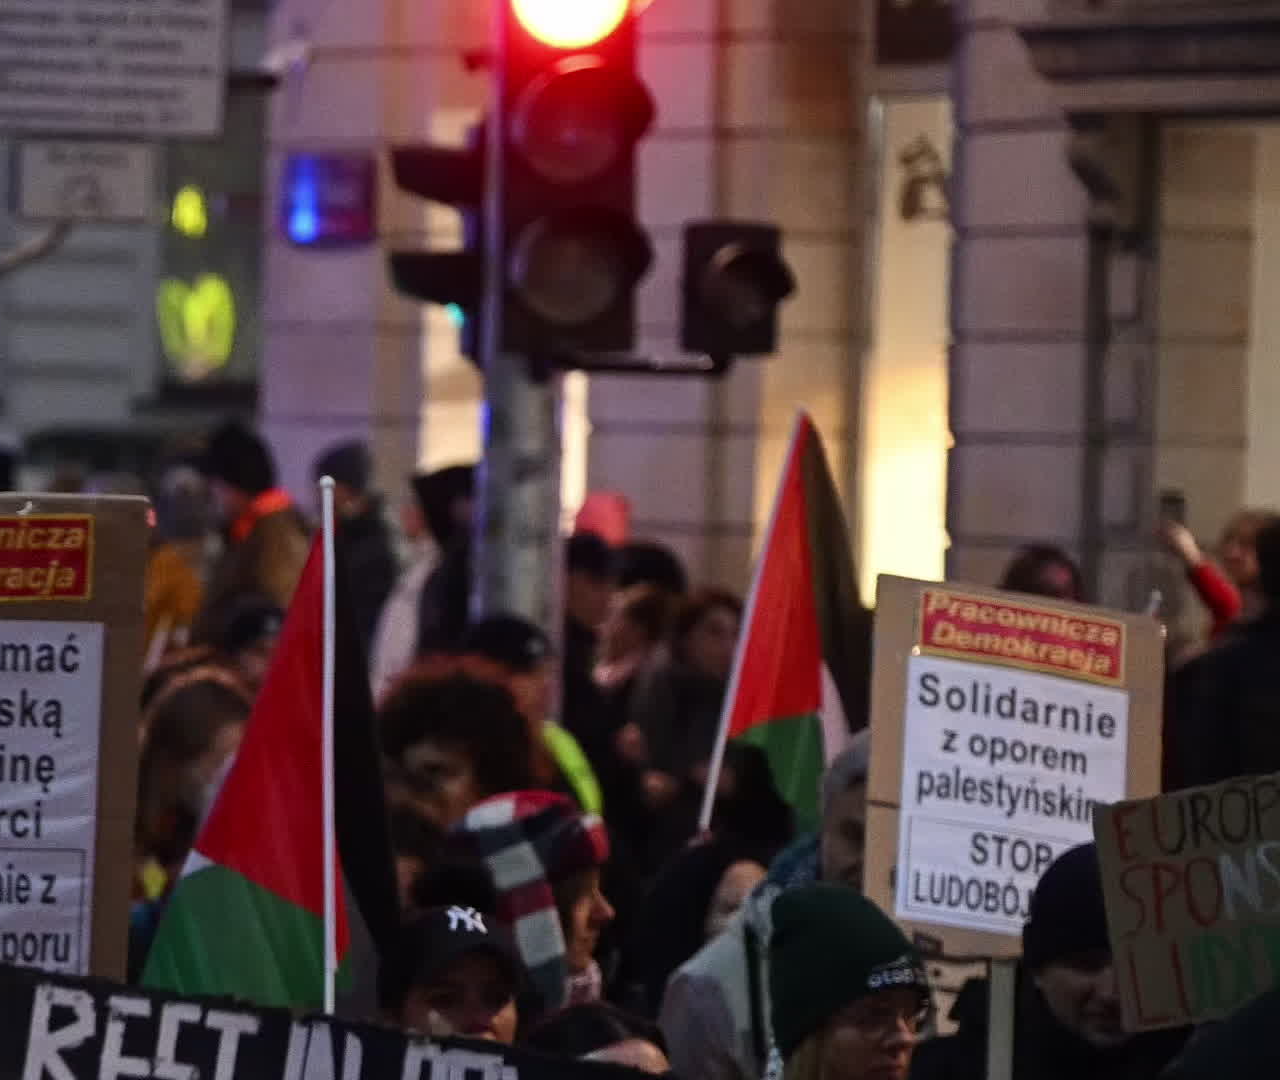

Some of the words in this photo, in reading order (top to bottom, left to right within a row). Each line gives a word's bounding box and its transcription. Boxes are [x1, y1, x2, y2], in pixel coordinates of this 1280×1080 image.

[925, 590, 1120, 646] Pracownicza
[931, 623, 1113, 675] Demokracja
[918, 673, 1118, 740] Solidarnie
[942, 728, 958, 754] z
[968, 731, 1089, 776] oporem
[970, 831, 1053, 876] STOP
[40, 873, 58, 905] z
[447, 905, 488, 935] NY
